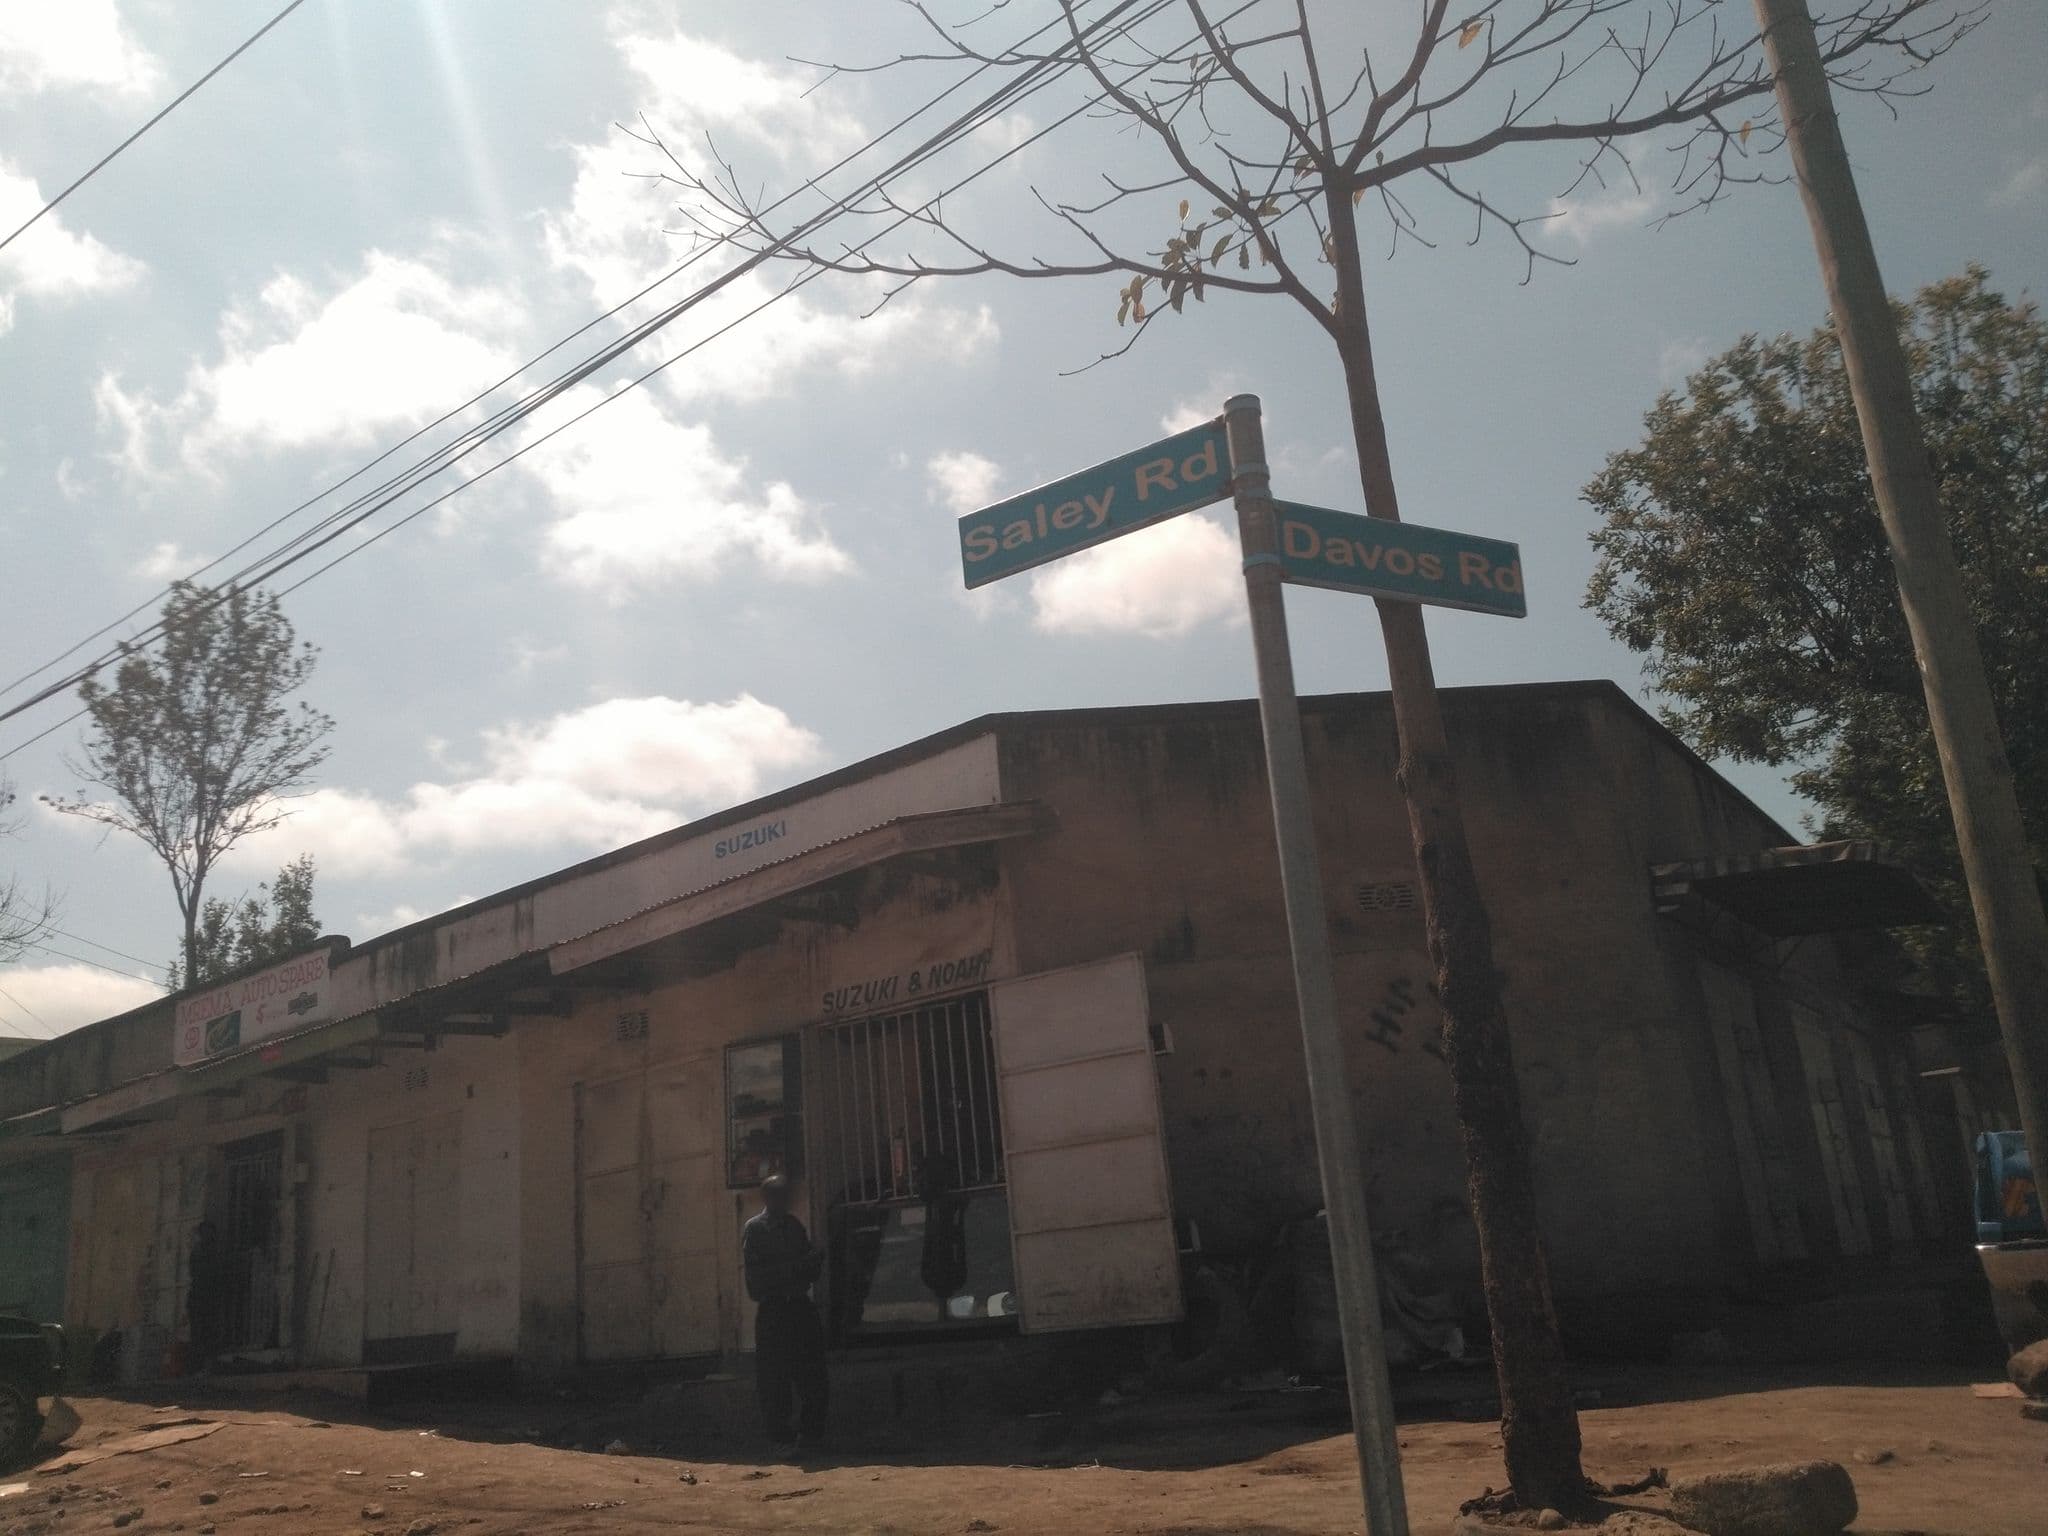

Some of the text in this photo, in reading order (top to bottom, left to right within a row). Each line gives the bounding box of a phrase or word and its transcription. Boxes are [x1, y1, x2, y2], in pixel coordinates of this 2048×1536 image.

[963, 440, 1219, 563] Saley Rd
[1282, 519, 1521, 593] Davos Rd
[714, 820, 788, 858] SUZUKI
[241, 973, 277, 1006] AUTO
[822, 976, 898, 1014] SUZUKI
